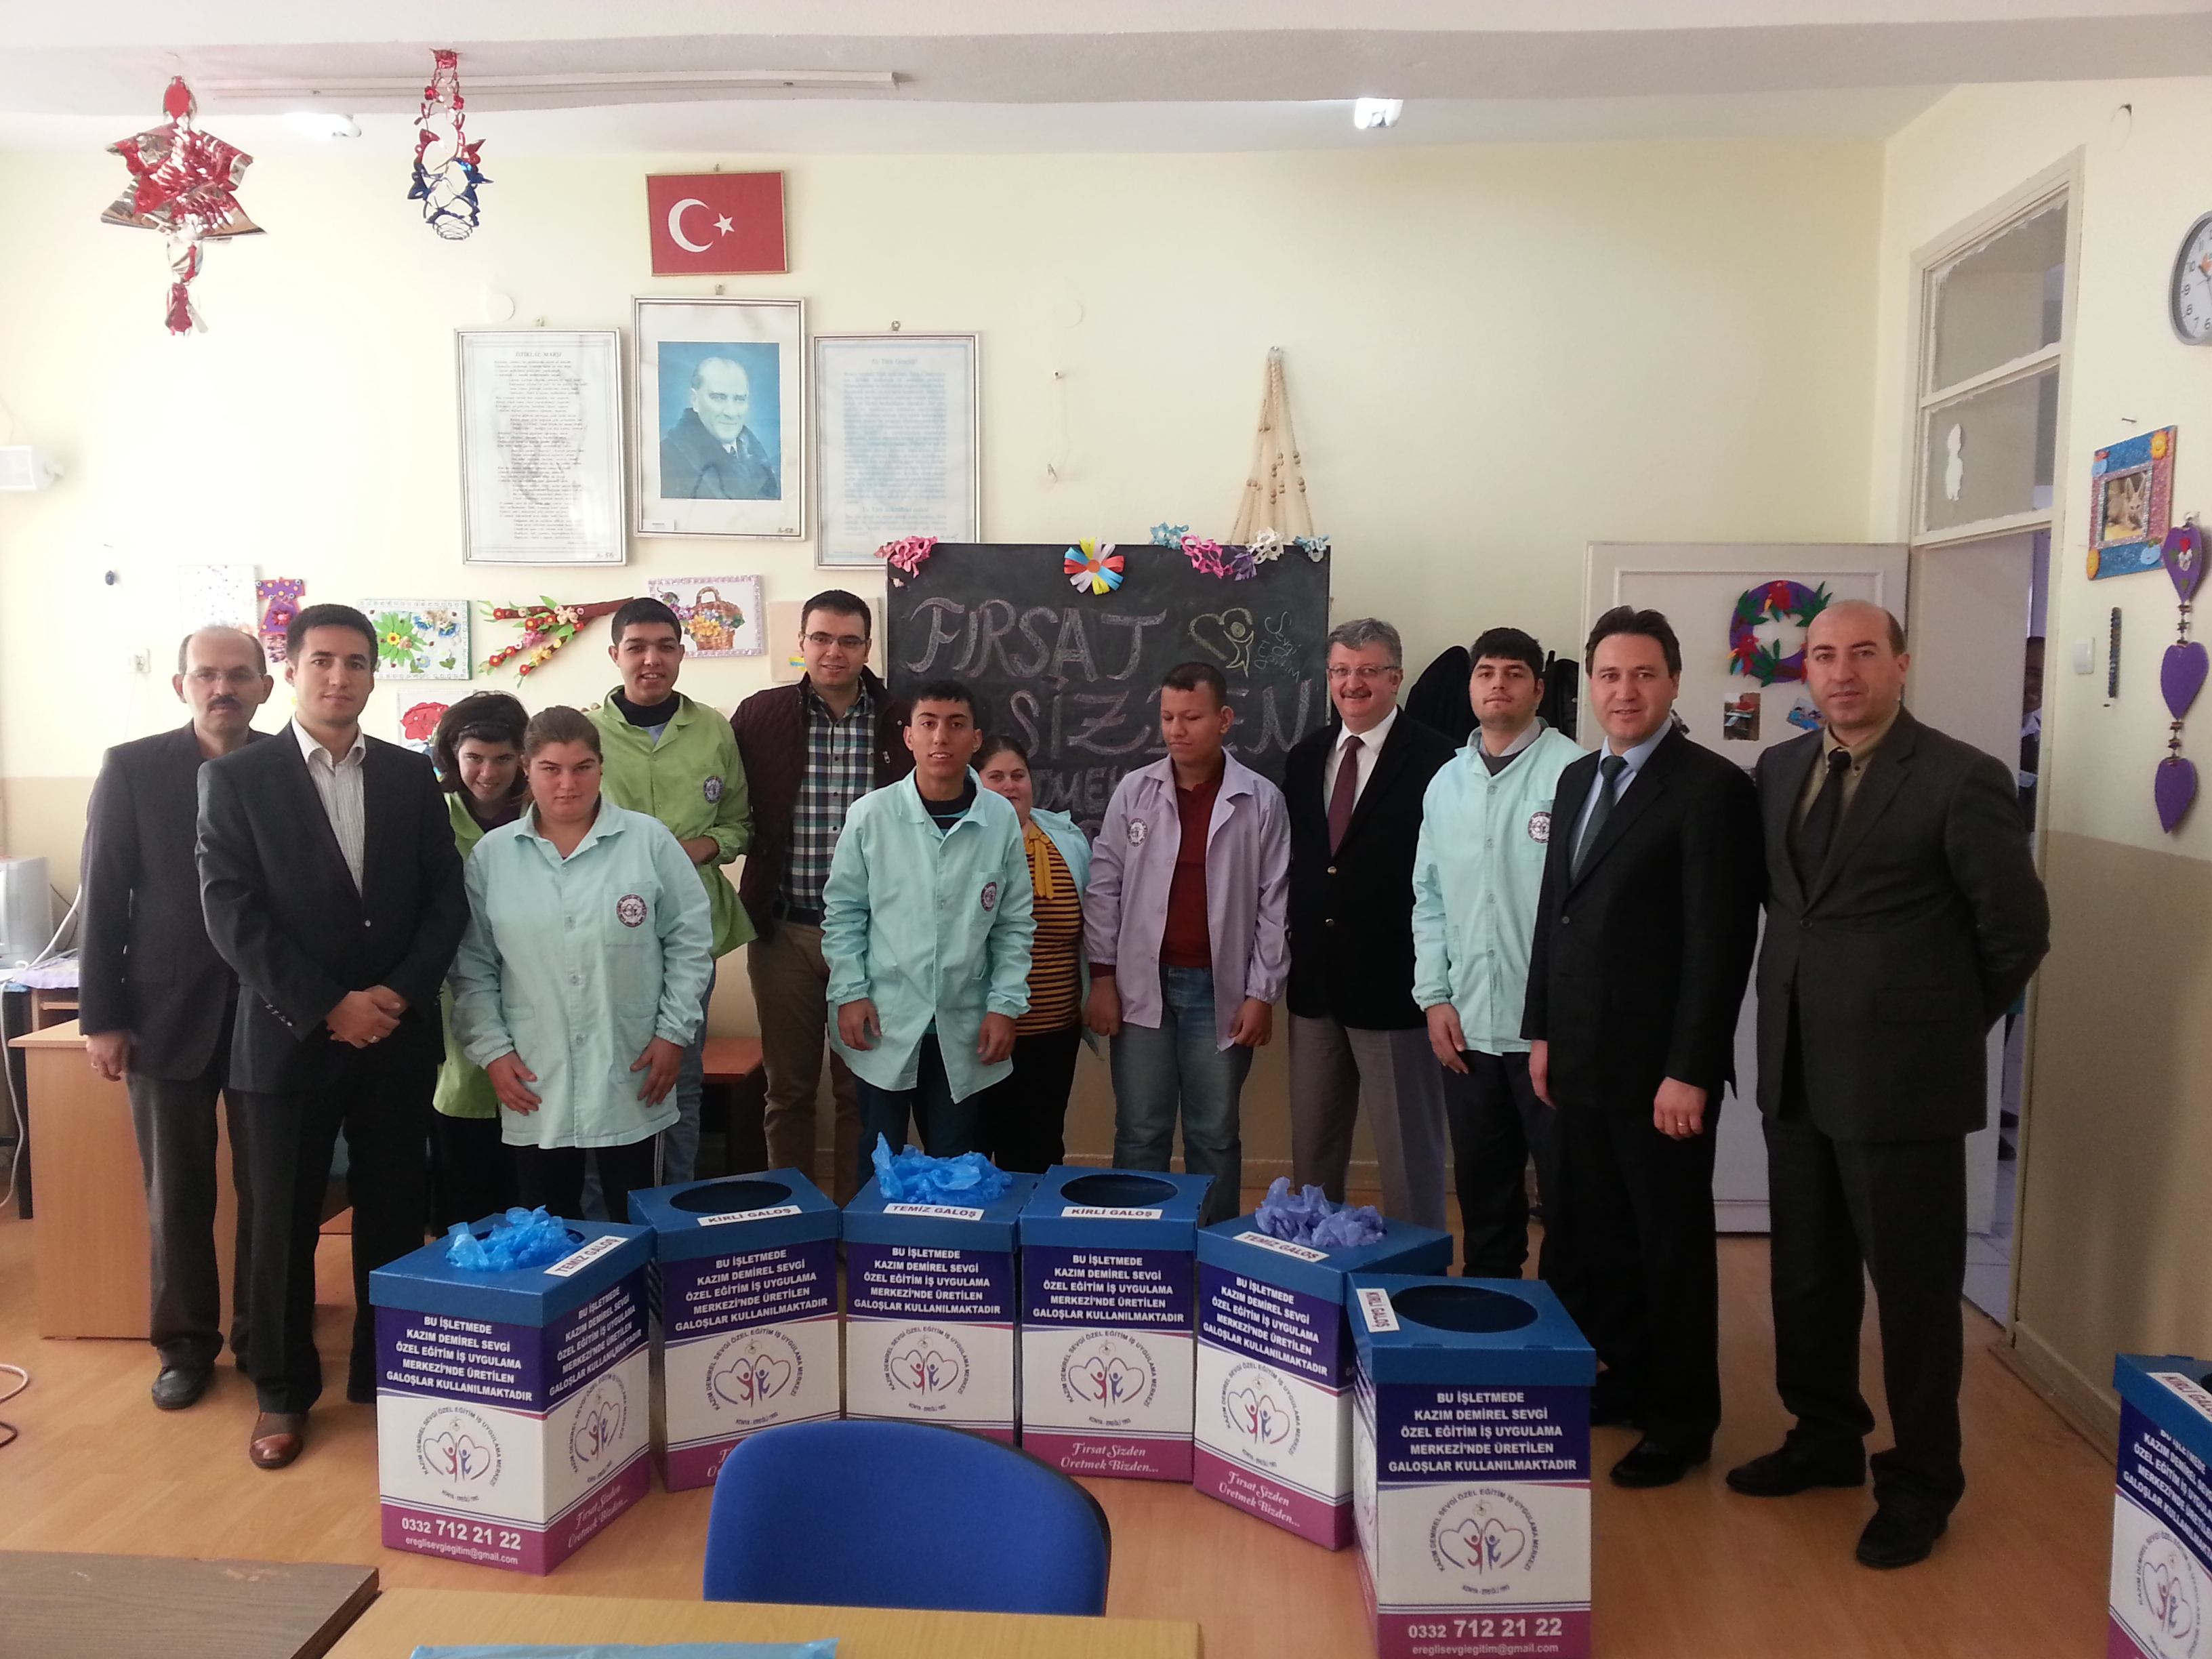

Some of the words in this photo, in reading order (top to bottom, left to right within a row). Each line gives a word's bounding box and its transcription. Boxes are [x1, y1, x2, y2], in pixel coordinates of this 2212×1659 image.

[2184, 284, 2190, 295] 9
[2194, 317, 2199, 329] 7
[2205, 318, 2211, 329] 6
[905, 597, 1167, 681] FIRSAT
[708, 1214, 743, 1223] KİRLİ
[747, 1208, 792, 1218] GALOŞ
[935, 1207, 977, 1218] GALOŞ
[1110, 1209, 1152, 1217] GALOŞ
[555, 1255, 589, 1272] TEMİZ
[584, 1238, 619, 1259] GALOŞ
[892, 1248, 905, 1256] BU
[908, 1247, 960, 1258] İŞLETMEDE
[1244, 1234, 1280, 1249] TEMİZ
[1279, 1245, 1320, 1259] GALOŞ
[716, 1260, 730, 1269] BU
[733, 1250, 787, 1267] İŞLETMEDE
[874, 1261, 903, 1270] KAZIM
[907, 1261, 947, 1273] DEMİREL
[950, 1263, 979, 1273] SEVGİ
[1073, 1255, 1086, 1264] BU
[1088, 1254, 1143, 1266] İŞLETMEDE
[697, 1271, 729, 1286] KAZIM
[732, 1265, 774, 1281] DEMİREL
[777, 1258, 805, 1272] SEVGİ
[863, 1272, 887, 1283] ÖZEL
[890, 1273, 922, 1284] EĞİTİM
[925, 1275, 934, 1287] İŞ
[937, 1277, 990, 1287] UYGULAMA
[1054, 1268, 1085, 1277] KAZIM
[1088, 1269, 1130, 1279] DEMİREL
[1132, 1270, 1161, 1280] SEVGİ
[686, 1291, 712, 1302] ÖZEL
[714, 1284, 749, 1297] EĞİTİM
[752, 1281, 761, 1292] İŞ
[764, 1272, 817, 1288] UYGULAMA
[871, 1287, 933, 1299] MERKEZİ'NDE
[936, 1290, 982, 1300] ÜRETİLEN
[1043, 1279, 1068, 1291] ÖZEL
[1071, 1282, 1104, 1292] EĞİTİM
[1107, 1282, 1116, 1294] İŞ
[1119, 1284, 1173, 1294] UYGULAMA
[1236, 1277, 1247, 1288] BU
[1249, 1279, 1294, 1305] İŞLETMEDE
[579, 1308, 588, 1319] BU
[589, 1286, 620, 1313] İŞLETMEDE
[693, 1296, 760, 1315] MERKEZİ'NDE
[762, 1287, 810, 1303] ÜRETİLEN
[854, 1299, 902, 1311] GALOŞLAR
[905, 1300, 1001, 1314] KULLANILMAKTADIR
[1050, 1296, 1115, 1306] MERKEZİ'NDE
[1118, 1296, 1166, 1308] ÜRETİLEN
[1221, 1286, 1246, 1302] KAZIM
[1248, 1296, 1282, 1315] DEMİREL
[1284, 1309, 1309, 1325] SEVGİ
[565, 1323, 587, 1342] KAZIM
[588, 1305, 613, 1328] DEMİREL
[614, 1292, 630, 1312] SEVGİ
[675, 1315, 729, 1332] GALOŞLAR
[731, 1298, 828, 1322] KULLANILMAKTADIR
[1033, 1308, 1084, 1319] GALOŞLAR
[1086, 1311, 1184, 1322] KULLANILMAKTADIR
[1212, 1296, 1231, 1311] ÖZEL
[1233, 1304, 1260, 1322] EĞİTİM
[1262, 1314, 1270, 1328] İŞ
[1272, 1319, 1319, 1343] UYGULAMA
[424, 1316, 436, 1326] BU
[440, 1317, 492, 1334] İŞLETMEDE
[557, 1345, 576, 1361] ÖZEL
[577, 1330, 599, 1351] EĞİTİM
[600, 1325, 607, 1337] İŞ
[607, 1305, 635, 1331] UYGULAMA
[1217, 1313, 1268, 1340] MERKEZİ'NDE
[1270, 1332, 1312, 1356] ÜRETİLEN
[407, 1329, 436, 1341] KAZIM
[438, 1334, 479, 1348] DEMİREL
[481, 1340, 510, 1352] SEVGİ
[562, 1340, 605, 1374] MERKEZİ'NDE
[607, 1322, 632, 1347] ÜRETİLEN
[1203, 1322, 1242, 1346] GALOŞLAR
[1244, 1339, 1328, 1376] KULLANILMAKTADIR
[396, 1341, 419, 1354] ÖZEL
[422, 1347, 453, 1359] EĞİTİM
[457, 1350, 466, 1364] İŞ
[468, 1354, 521, 1369] UYGULAMA
[549, 1366, 586, 1396] GALOŞLAR
[587, 1329, 641, 1374] KULLANILMAKTADIR
[403, 1359, 464, 1376] MERKEZİ'NDE
[467, 1368, 514, 1383] ÜRETİLEN
[387, 1371, 434, 1387] GALOŞLAR
[436, 1380, 532, 1401] KULLANILMAKTADIR
[1437, 1393, 1454, 1404] BU
[1457, 1391, 1524, 1406] İŞLETMEDE
[1414, 1410, 1453, 1421] KAZIM
[1456, 1408, 1509, 1420] DEMİREL
[1512, 1407, 1548, 1419] SEVGİ
[1401, 1426, 1432, 1438] ÖZEL
[1435, 1426, 1477, 1438] EĞİTİM
[1481, 1426, 1492, 1439] İŞ
[1495, 1427, 1563, 1437] UYGULAMA
[1072, 1442, 1105, 1456] Fırsat
[1107, 1445, 1146, 1458] Sizden
[1410, 1443, 1491, 1455] MERKEZİ'NDE
[1494, 1443, 1554, 1454] ÜRETİLEN
[1389, 1461, 1452, 1474] GALOŞLAR
[1455, 1460, 1576, 1472] KULLANILMAKTADIR
[402, 1518, 431, 1534] 0332
[436, 1519, 468, 1540] 712
[473, 1527, 492, 1544] 21
[499, 1532, 521, 1550] 22
[405, 1537, 518, 1565] ereglisevgiegitim@gmail.com
[1408, 1626, 1446, 1638] 0332
[1454, 1619, 1494, 1638] 712
[1502, 1619, 1526, 1637] 21
[1536, 1618, 1563, 1636] 22
[1412, 1644, 1558, 1656] ereglisevgiegitim@gmail.com
